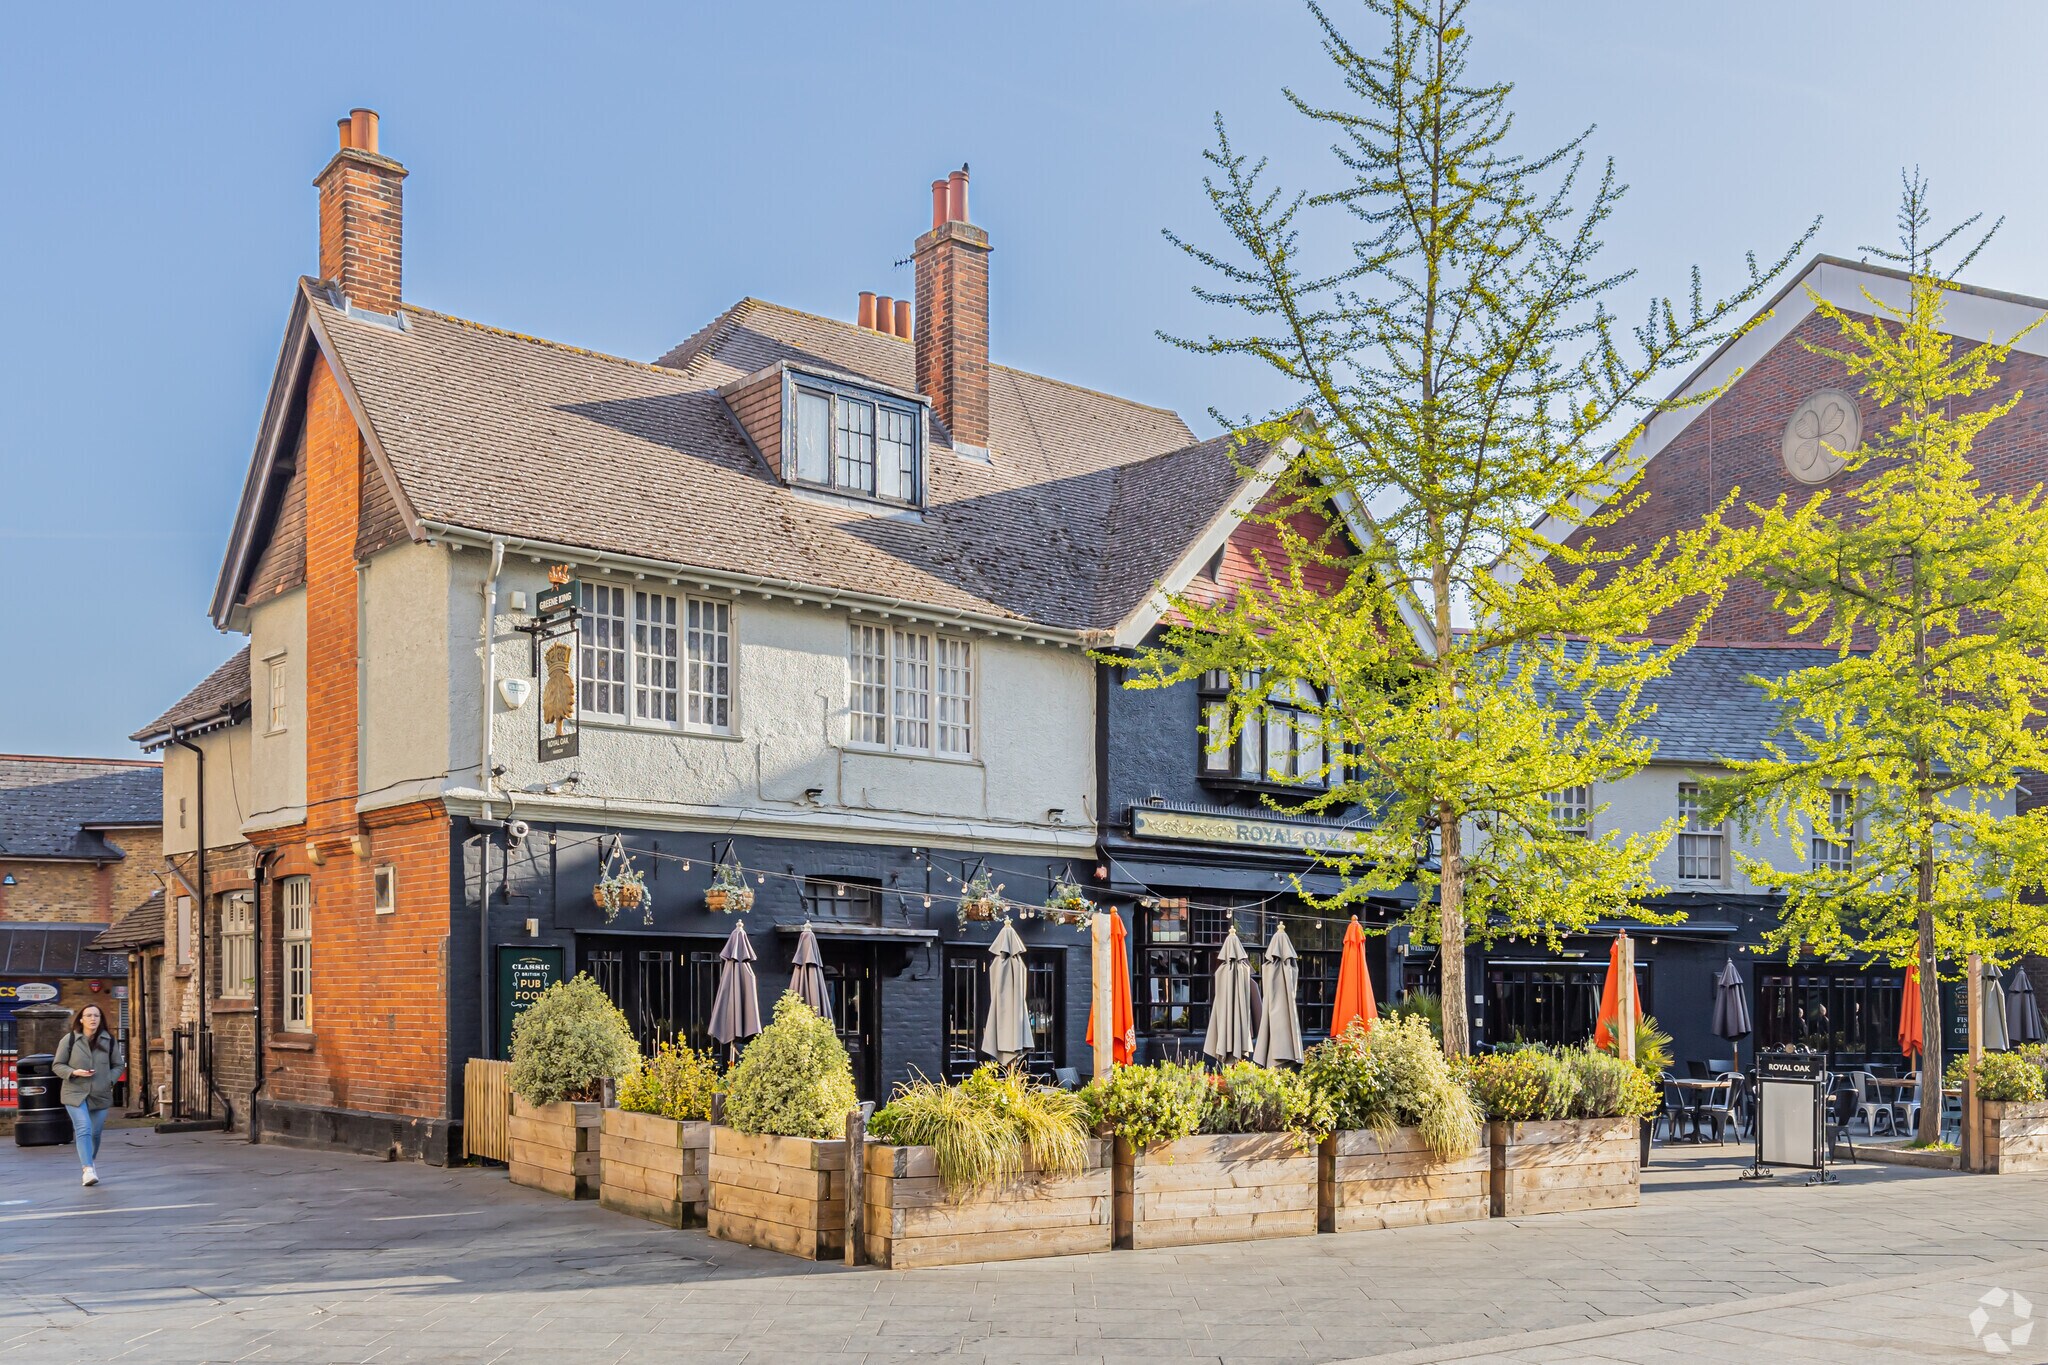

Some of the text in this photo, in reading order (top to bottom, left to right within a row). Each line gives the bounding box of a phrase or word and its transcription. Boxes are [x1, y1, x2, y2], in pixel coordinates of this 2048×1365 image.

[539, 596, 558, 610] GREENE
[558, 592, 572, 604] KING
[547, 737, 570, 748] ROYAL OAK
[1236, 824, 1299, 846] ROYAL
[512, 963, 550, 971] CLASSIC
[520, 979, 541, 988] PUB
[1768, 1063, 1792, 1071] ROYAL
